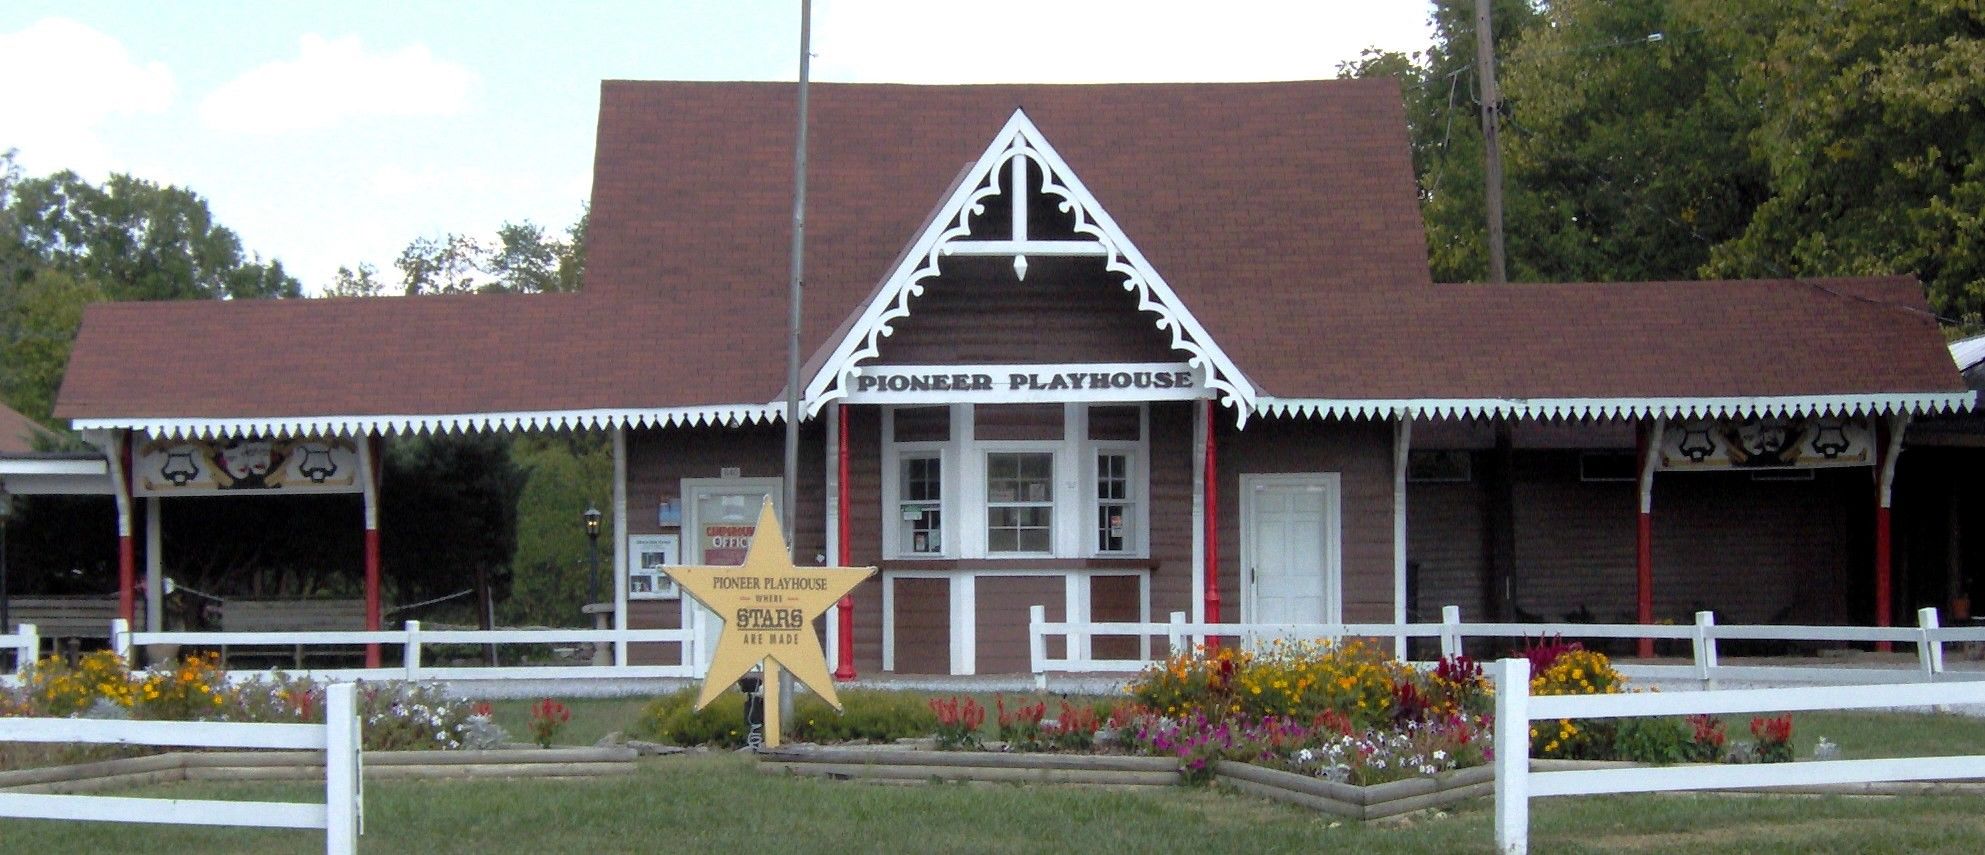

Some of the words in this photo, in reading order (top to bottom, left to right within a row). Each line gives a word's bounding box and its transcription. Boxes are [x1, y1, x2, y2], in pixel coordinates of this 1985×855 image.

[857, 373, 993, 392] PIONEER
[1008, 371, 1194, 391] PLAYHOUSE
[712, 536, 750, 548] OFFIC
[713, 576, 761, 590] PIONEER
[764, 577, 828, 591] PLAYHOUSE
[755, 594, 783, 603] WHERE
[736, 608, 803, 629] STARS
[743, 633, 763, 645] ARE
[769, 633, 798, 645] MADE
